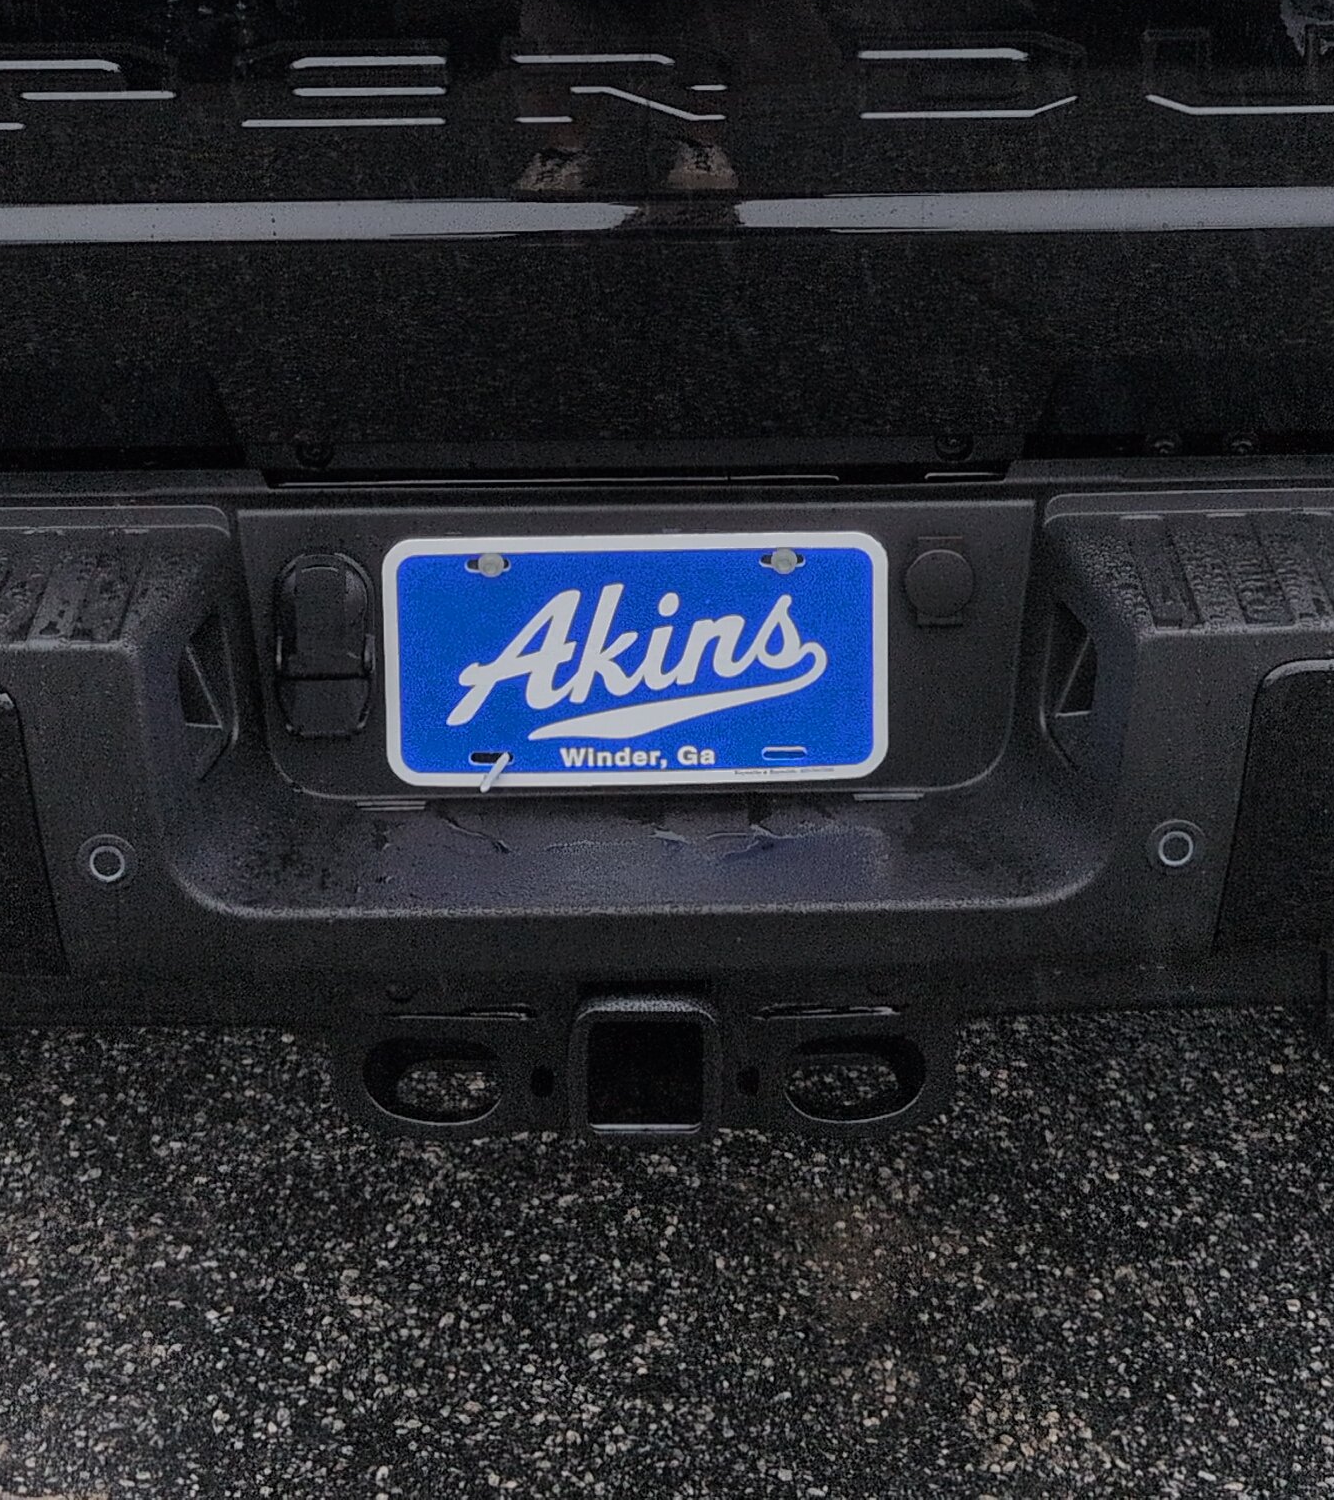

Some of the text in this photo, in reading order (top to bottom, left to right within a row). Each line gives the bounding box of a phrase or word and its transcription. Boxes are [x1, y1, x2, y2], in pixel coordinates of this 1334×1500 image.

[446, 582, 829, 738] Akins
[560, 745, 716, 769] Winder, Ga
